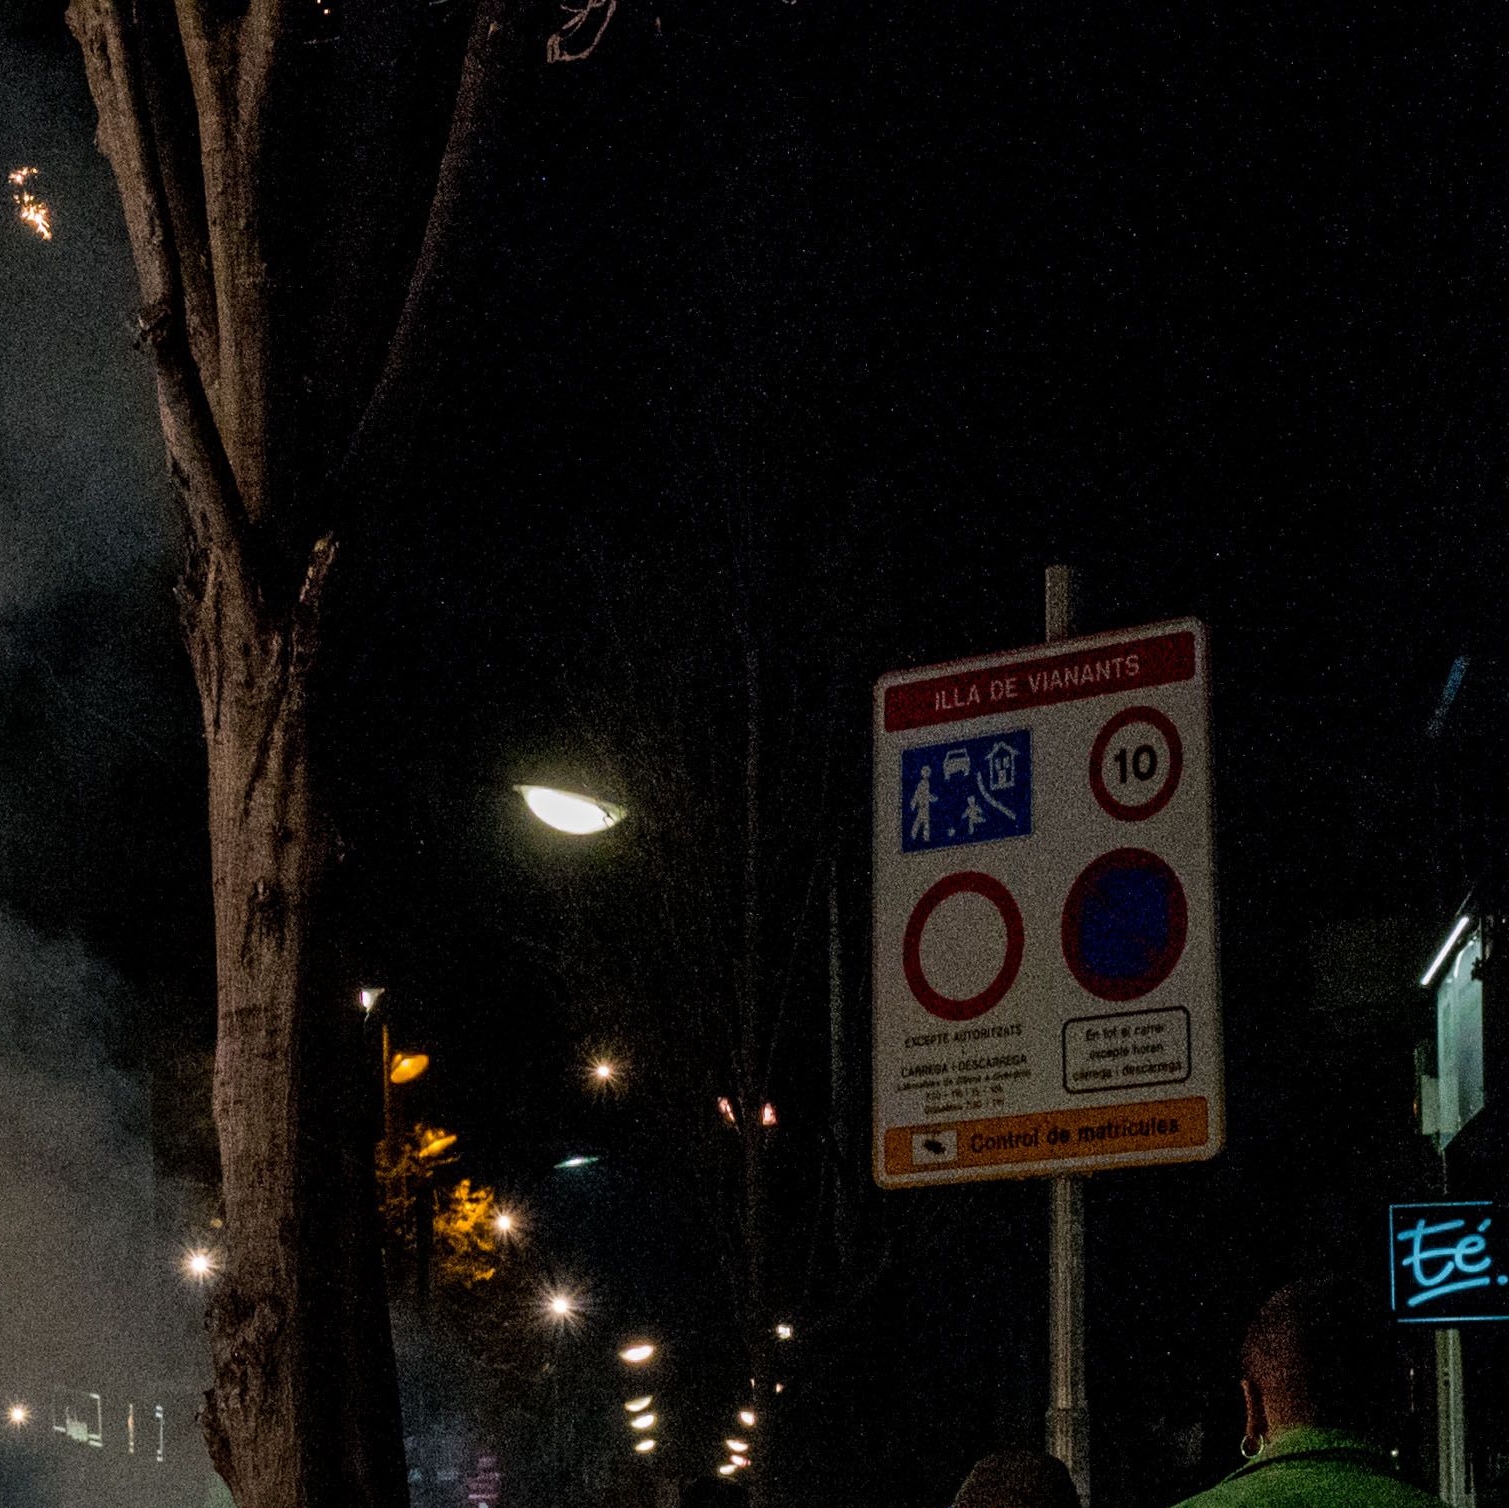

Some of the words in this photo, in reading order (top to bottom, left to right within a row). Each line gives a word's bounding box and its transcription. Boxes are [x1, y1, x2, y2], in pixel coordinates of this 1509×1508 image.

[934, 684, 980, 712] ILLA
[989, 677, 1018, 701] DE
[1028, 654, 1141, 694] VIANANTS
[1114, 744, 1157, 784] 10
[904, 1033, 949, 1049] EXCEPTE
[953, 1024, 1022, 1042] AUTORITZATS
[1086, 1029, 1099, 1041] En
[970, 1127, 1039, 1153] Control
[1047, 1125, 1070, 1145] de
